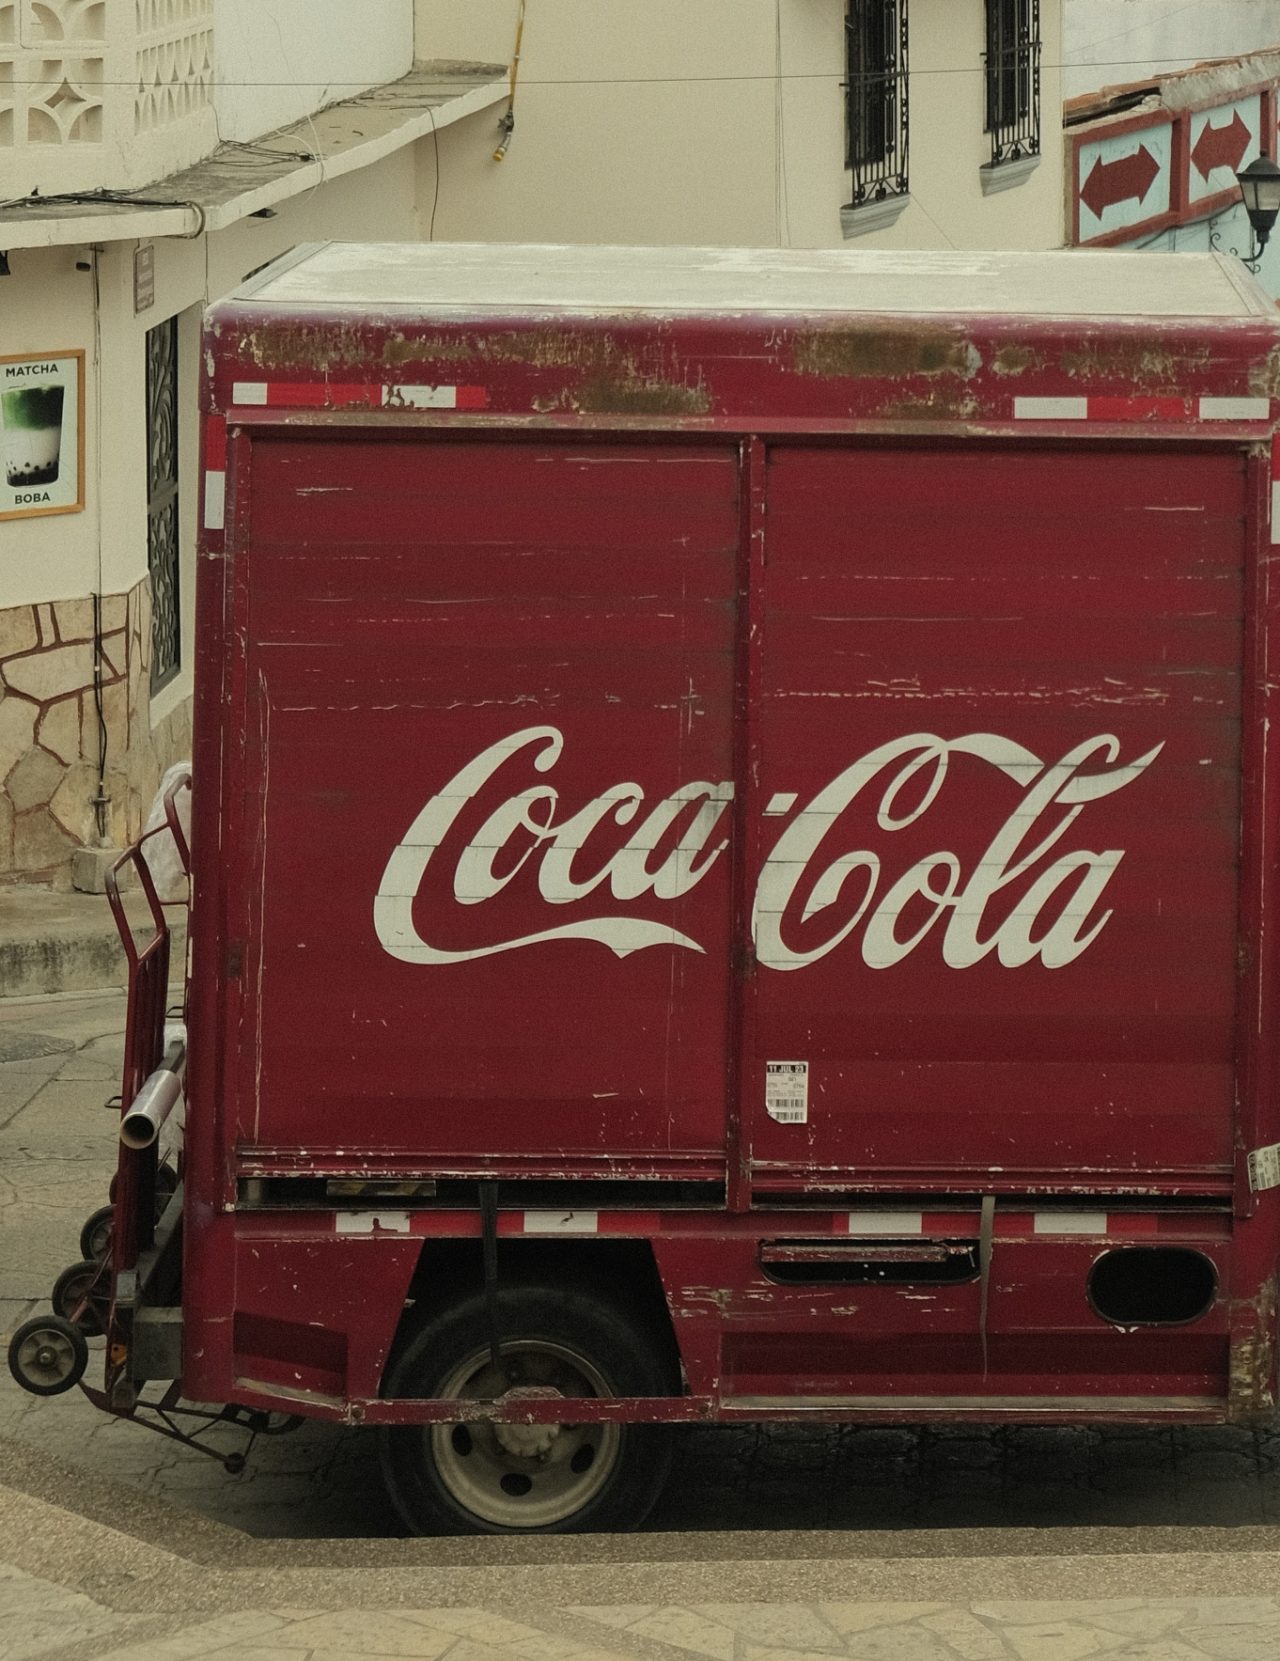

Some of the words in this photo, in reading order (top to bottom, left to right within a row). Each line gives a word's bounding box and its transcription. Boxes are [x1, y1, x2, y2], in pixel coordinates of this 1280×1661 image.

[5, 363, 59, 378] MATCHA
[14, 491, 51, 504] BOBA
[373, 725, 1166, 971] Coca-Cola
